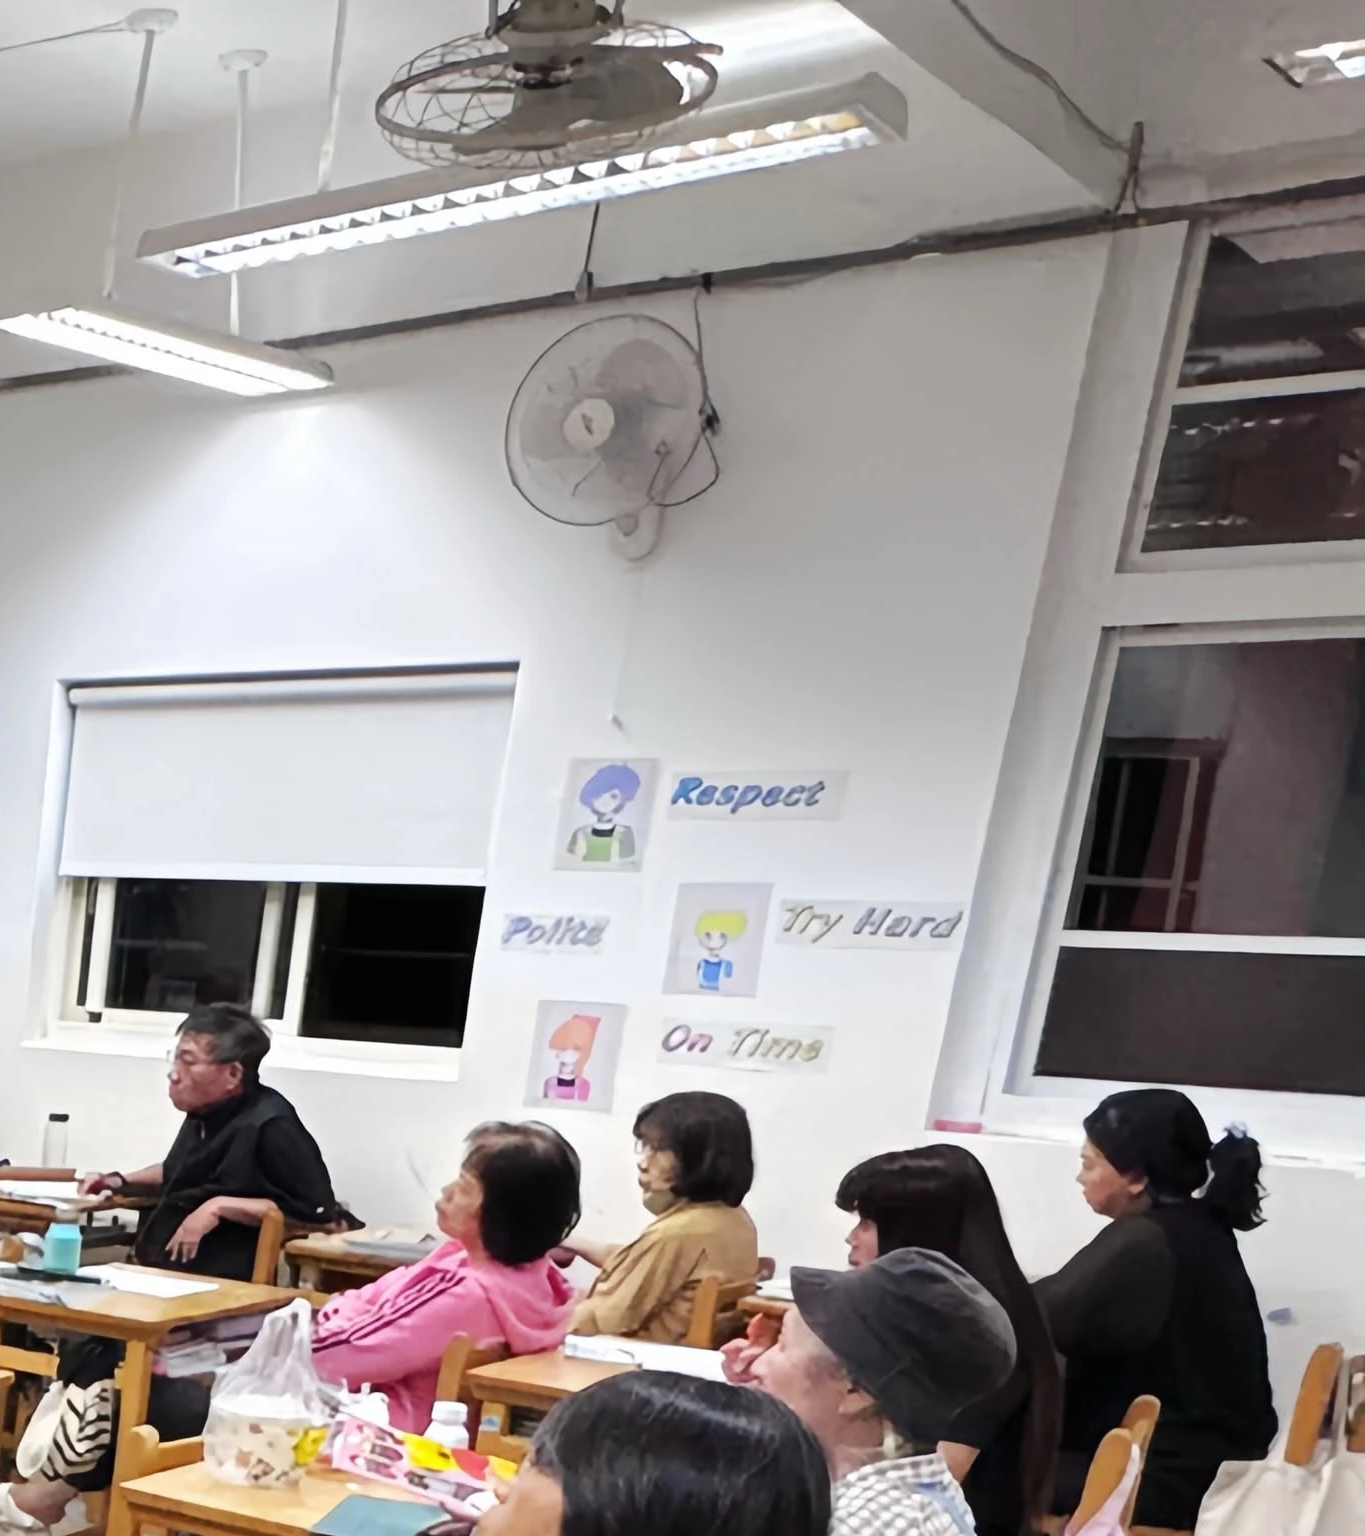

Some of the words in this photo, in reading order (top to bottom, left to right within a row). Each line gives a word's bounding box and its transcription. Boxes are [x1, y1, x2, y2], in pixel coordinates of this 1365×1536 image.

[671, 776, 826, 815] Respect
[501, 916, 607, 947] Polite
[783, 905, 844, 944] Try
[852, 907, 965, 938] Hard
[661, 1024, 713, 1053] On
[728, 1028, 825, 1062] Time
